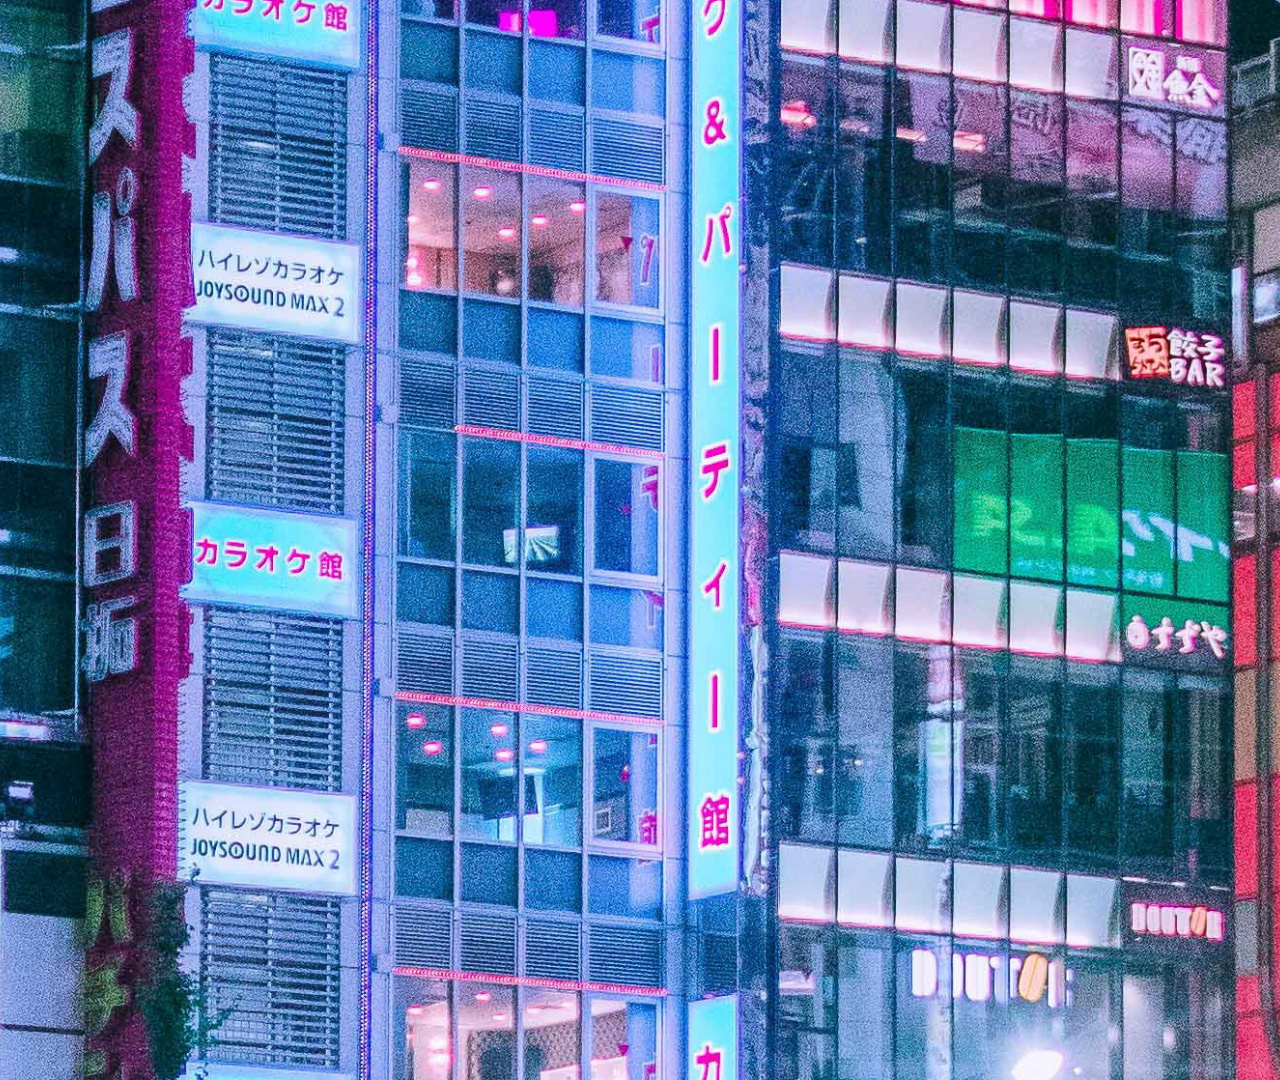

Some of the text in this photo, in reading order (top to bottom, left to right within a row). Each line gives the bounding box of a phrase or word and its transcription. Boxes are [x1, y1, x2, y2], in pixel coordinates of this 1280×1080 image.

[197, 249, 345, 287] ハイレゾカラオケ
[196, 279, 346, 319] JOYSOUND MAX 2
[1169, 358, 1226, 387] BAR
[194, 537, 344, 581] カラオケ館
[192, 808, 340, 839] ハイレゾカラオケ
[191, 837, 342, 870] JOYSOUND MAX 2
